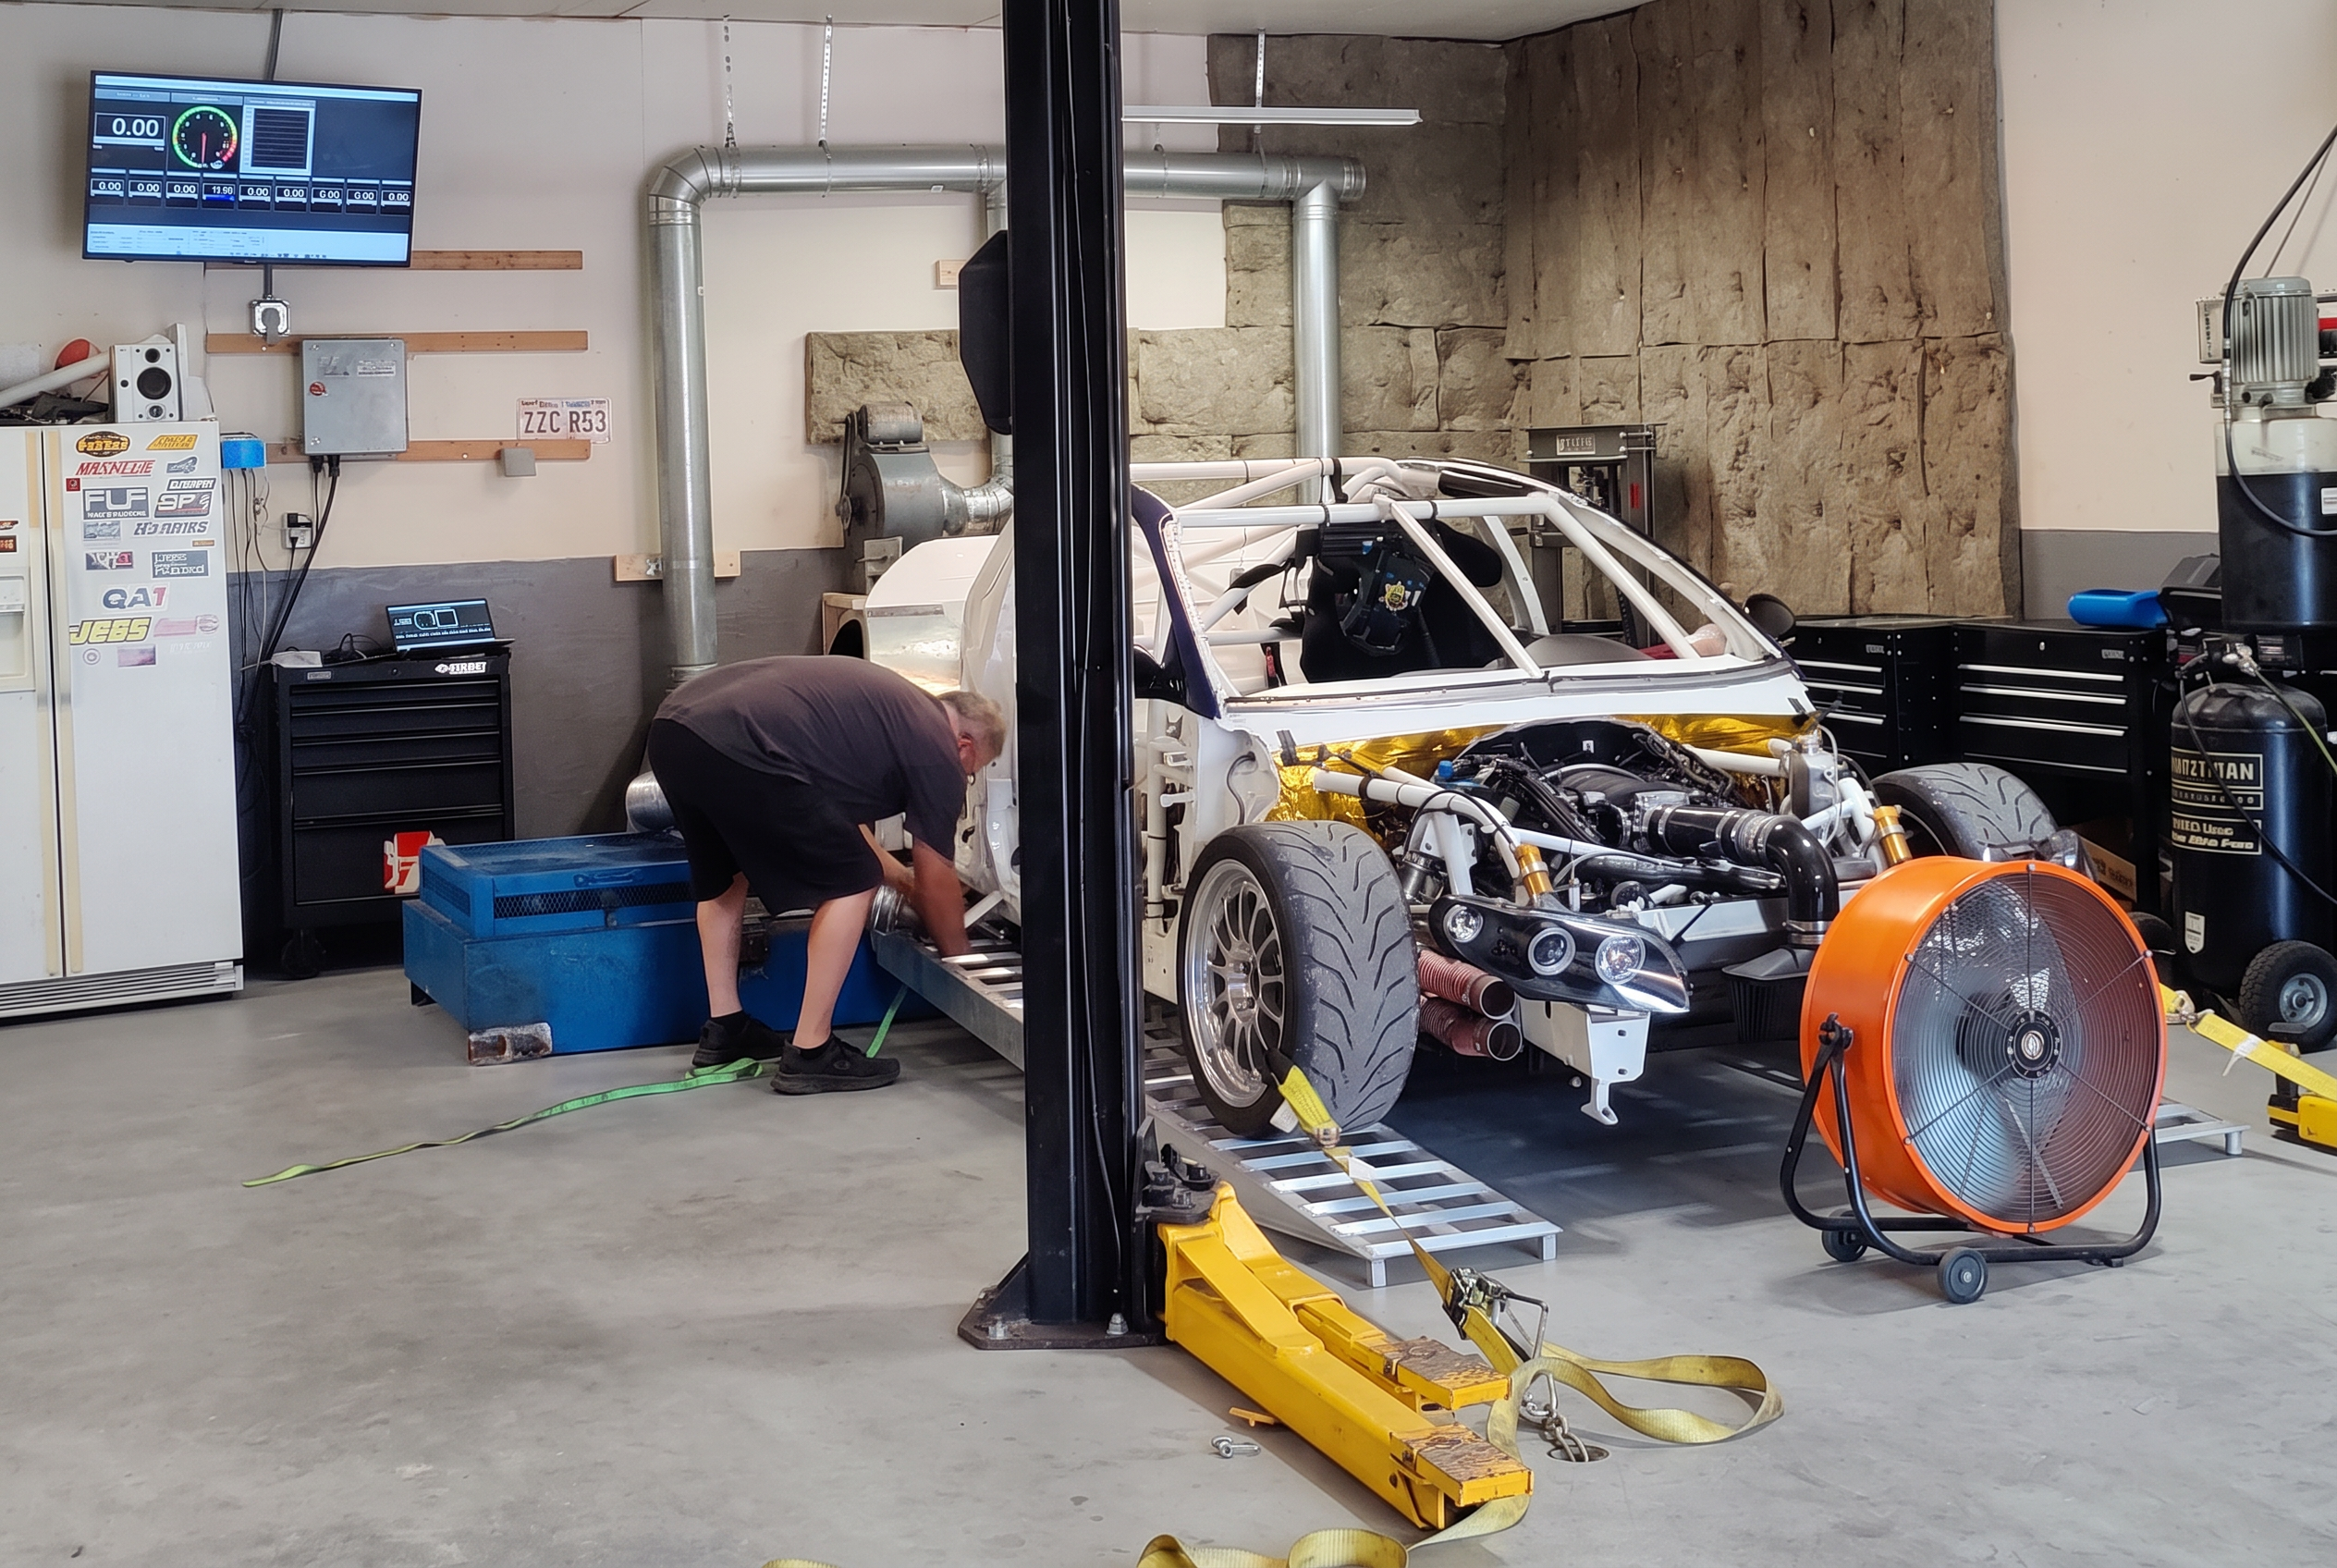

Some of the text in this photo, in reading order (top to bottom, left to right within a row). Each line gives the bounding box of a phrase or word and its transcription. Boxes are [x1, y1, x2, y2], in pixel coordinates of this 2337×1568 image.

[112, 117, 159, 137] 0.00
[523, 410, 607, 434] ZZC R53
[103, 587, 166, 609] QA1
